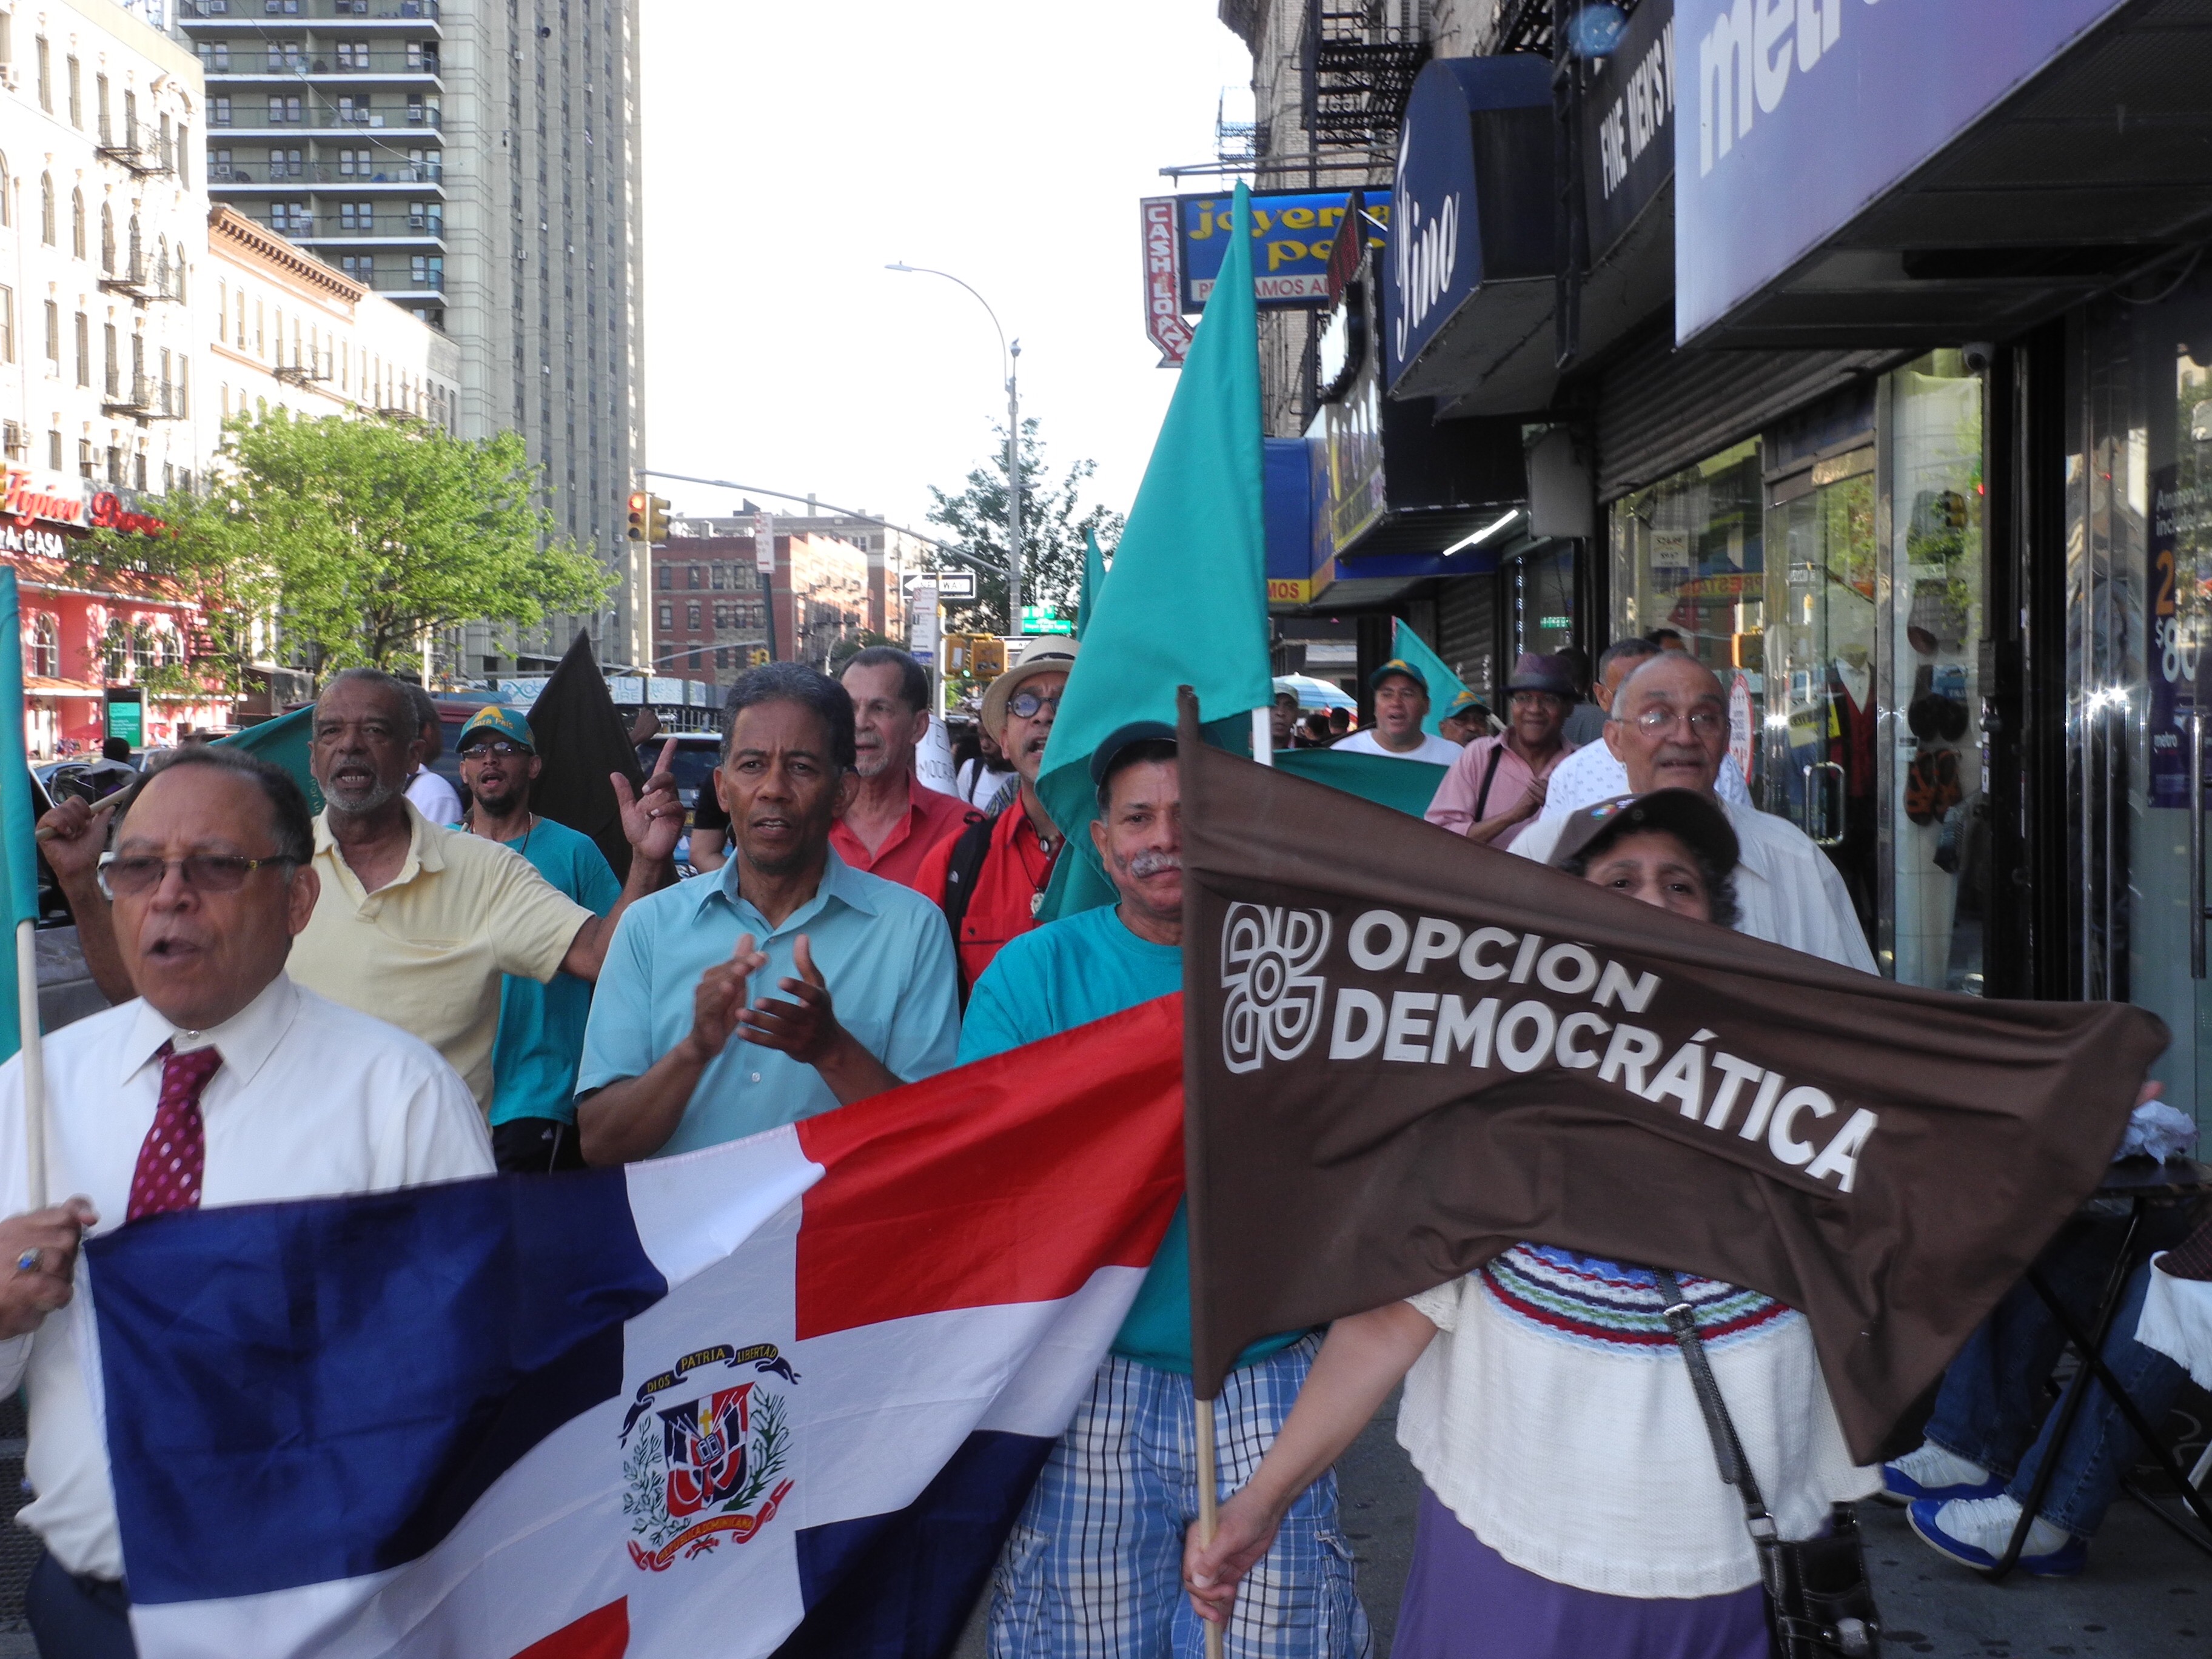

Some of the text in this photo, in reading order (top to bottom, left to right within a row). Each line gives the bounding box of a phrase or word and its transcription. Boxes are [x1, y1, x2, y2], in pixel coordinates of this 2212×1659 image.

[1600, 96, 1627, 200] FINE
[1148, 206, 1173, 273] CASH
[24, 529, 64, 559] CASA
[1329, 988, 1878, 1193] DEMOCRÁTICA
[647, 1345, 779, 1393] DIOS PATRIA LIBERTAD
